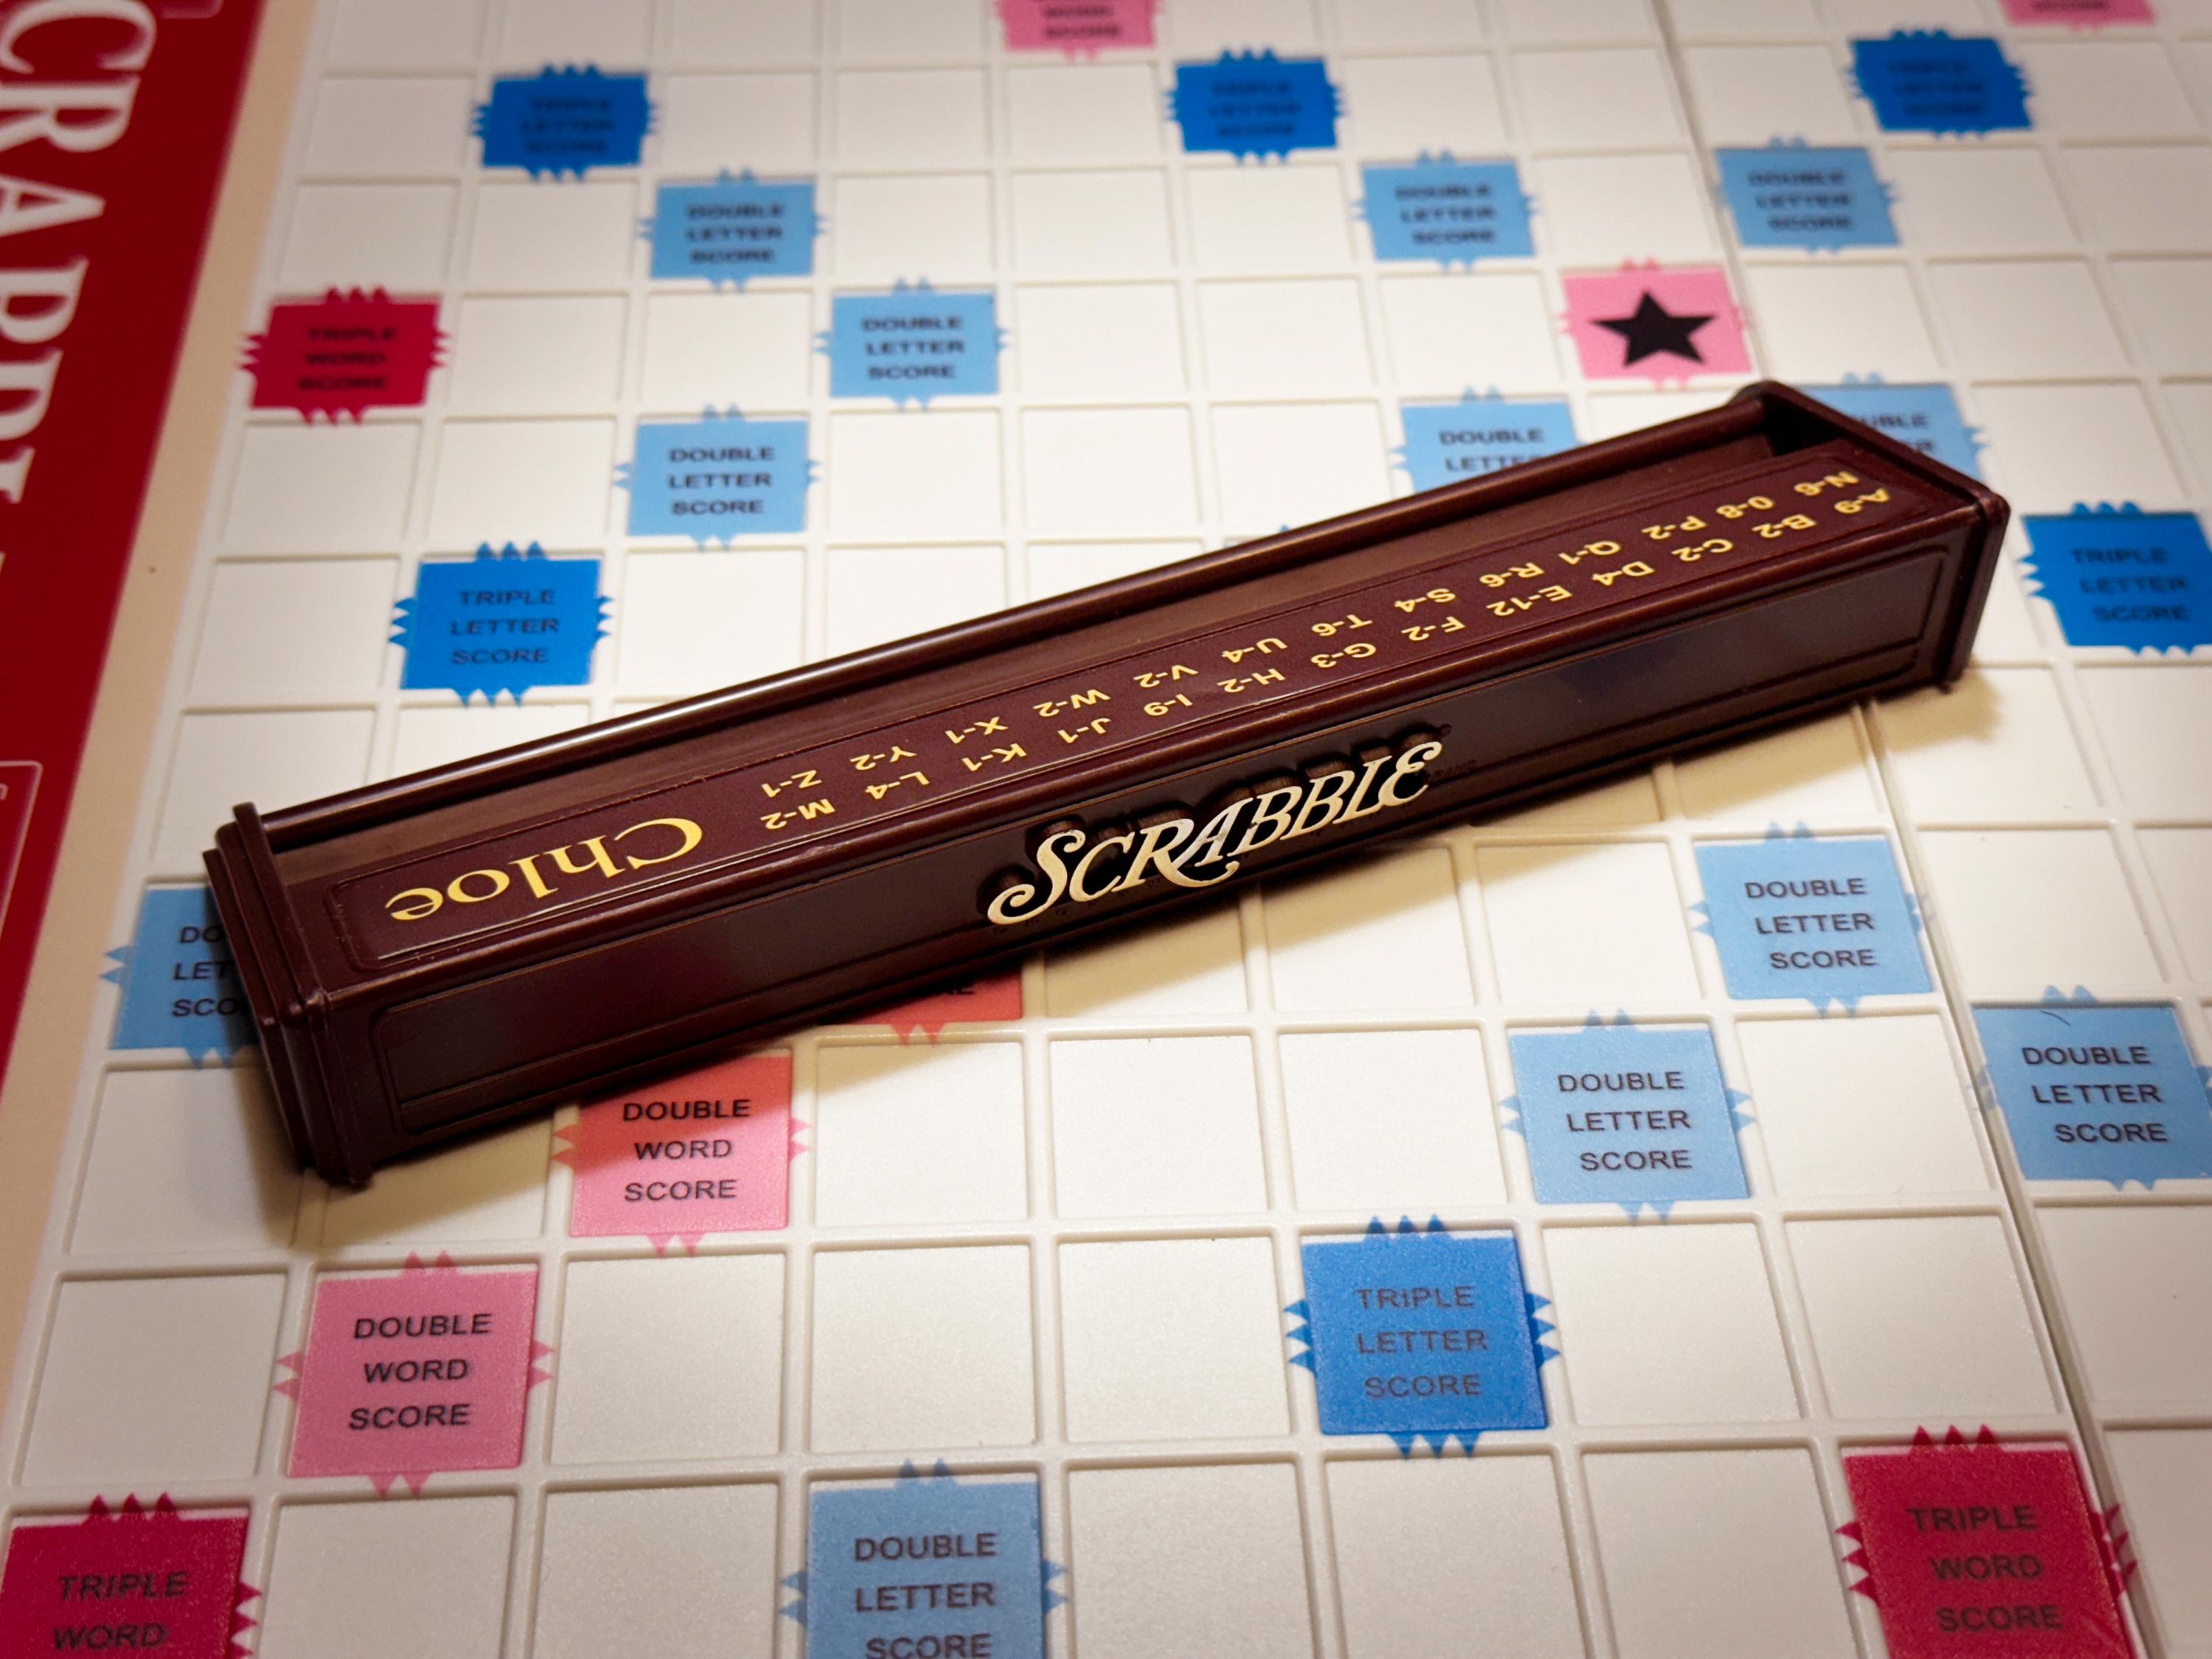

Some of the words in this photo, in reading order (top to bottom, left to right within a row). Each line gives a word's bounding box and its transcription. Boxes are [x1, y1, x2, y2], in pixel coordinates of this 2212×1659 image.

[1749, 170, 1846, 186] DOUBLE
[1395, 184, 1492, 199] DOUBLE
[1756, 192, 1851, 209] LETTER
[686, 204, 783, 220] DOUBLE
[1400, 206, 1496, 223] LETTER
[1768, 215, 1853, 230] SCORE
[685, 226, 782, 243] LETTER
[1412, 229, 1495, 244] SCORE
[689, 248, 773, 264] SCORE
[307, 327, 396, 341] TRIPLE
[861, 316, 961, 332] DOUBLE
[305, 351, 386, 366] WORD
[865, 339, 964, 356] LETTER
[296, 376, 386, 392] SCORE
[867, 364, 953, 380] SCORE
[1439, 428, 1543, 445] DOUBLE
[668, 447, 773, 463] DOUBLE
[667, 473, 772, 490] LETTER
[671, 499, 762, 515] SCORE
[1641, 515, 1707, 540] P-2
[1752, 514, 1816, 538] B-2
[1558, 540, 1621, 565] Q-1
[1672, 538, 1733, 562] C-2
[2073, 546, 2171, 566] TRIPLE
[1479, 562, 1545, 588] R-6
[1591, 560, 1655, 586] D-4
[2081, 574, 2194, 595] LETTER
[458, 589, 553, 607] TRIPLE
[1394, 588, 1457, 613] S-4
[1486, 585, 1572, 616] E-12
[1311, 614, 1374, 636] T-6
[2094, 603, 2192, 623] SCORE
[448, 618, 559, 637] LETTER
[1401, 616, 1467, 641] F-2
[449, 647, 546, 666] SCORE
[1221, 638, 1289, 663] U-4
[1310, 642, 1377, 668] G-3
[1133, 664, 1200, 688] V-2
[1216, 668, 1287, 693] H-2
[1032, 689, 1112, 717] W-2
[945, 716, 1009, 744] X-1
[1057, 717, 1112, 744] J-1
[849, 745, 918, 771] Y-2
[961, 742, 1027, 771] K-1
[761, 769, 823, 798] Z-1
[864, 771, 930, 800] L-4
[760, 799, 835, 830] M-2
[987, 741, 1442, 925] SCRABBLE
[385, 817, 703, 921] Chloe
[1744, 877, 1867, 900] DOUBLE
[1755, 912, 1875, 936] LETTER
[1769, 948, 1877, 970] SCORE
[2022, 1046, 2153, 1066] DOUBLE
[1557, 1071, 1686, 1093] DOUBLE
[2031, 1083, 2165, 1105] LETTER
[622, 1098, 751, 1122] DOUBLE
[1566, 1109, 1691, 1133] LETTER
[2054, 1122, 2169, 1144] SCORE
[633, 1138, 734, 1162] WORD
[1579, 1149, 1693, 1172] SCORE
[624, 1179, 737, 1203] SCORE
[1354, 1284, 1476, 1310] TRIPLE
[352, 1312, 492, 1340] DOUBLE
[1357, 1328, 1489, 1355] LETTER
[363, 1358, 470, 1384] WORD
[1364, 1374, 1484, 1399] SCORE
[347, 1402, 470, 1431] SCORE
[1907, 1504, 2039, 1532] TRIPLE
[854, 1532, 996, 1562] DOUBLE
[1929, 1554, 2043, 1581] WORD
[57, 1570, 189, 1601] TRIPLE
[855, 1582, 996, 1613] LETTER
[1936, 1603, 2063, 1632] SCORE
[52, 1622, 165, 1651] WORD
[865, 1632, 991, 1659] SCORE
